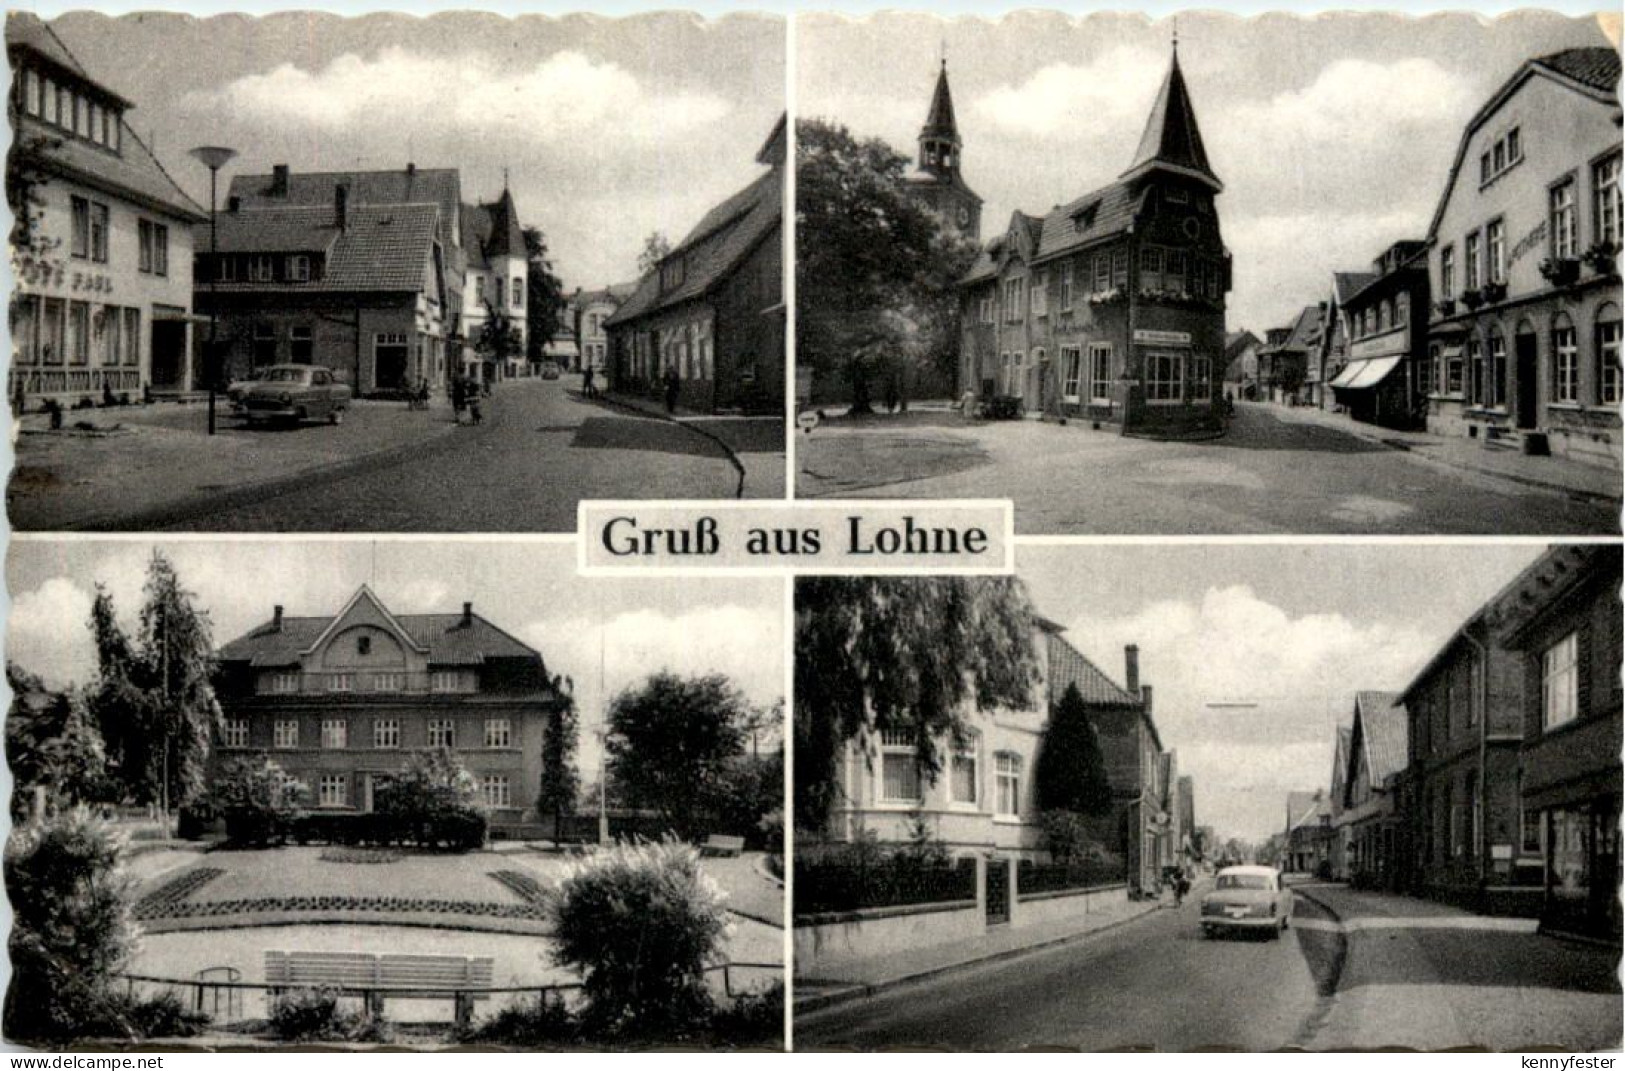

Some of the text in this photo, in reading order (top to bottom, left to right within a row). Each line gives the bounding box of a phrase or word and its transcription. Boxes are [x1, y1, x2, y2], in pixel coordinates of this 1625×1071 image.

[602, 516, 988, 556] Gruß aus Lohne
